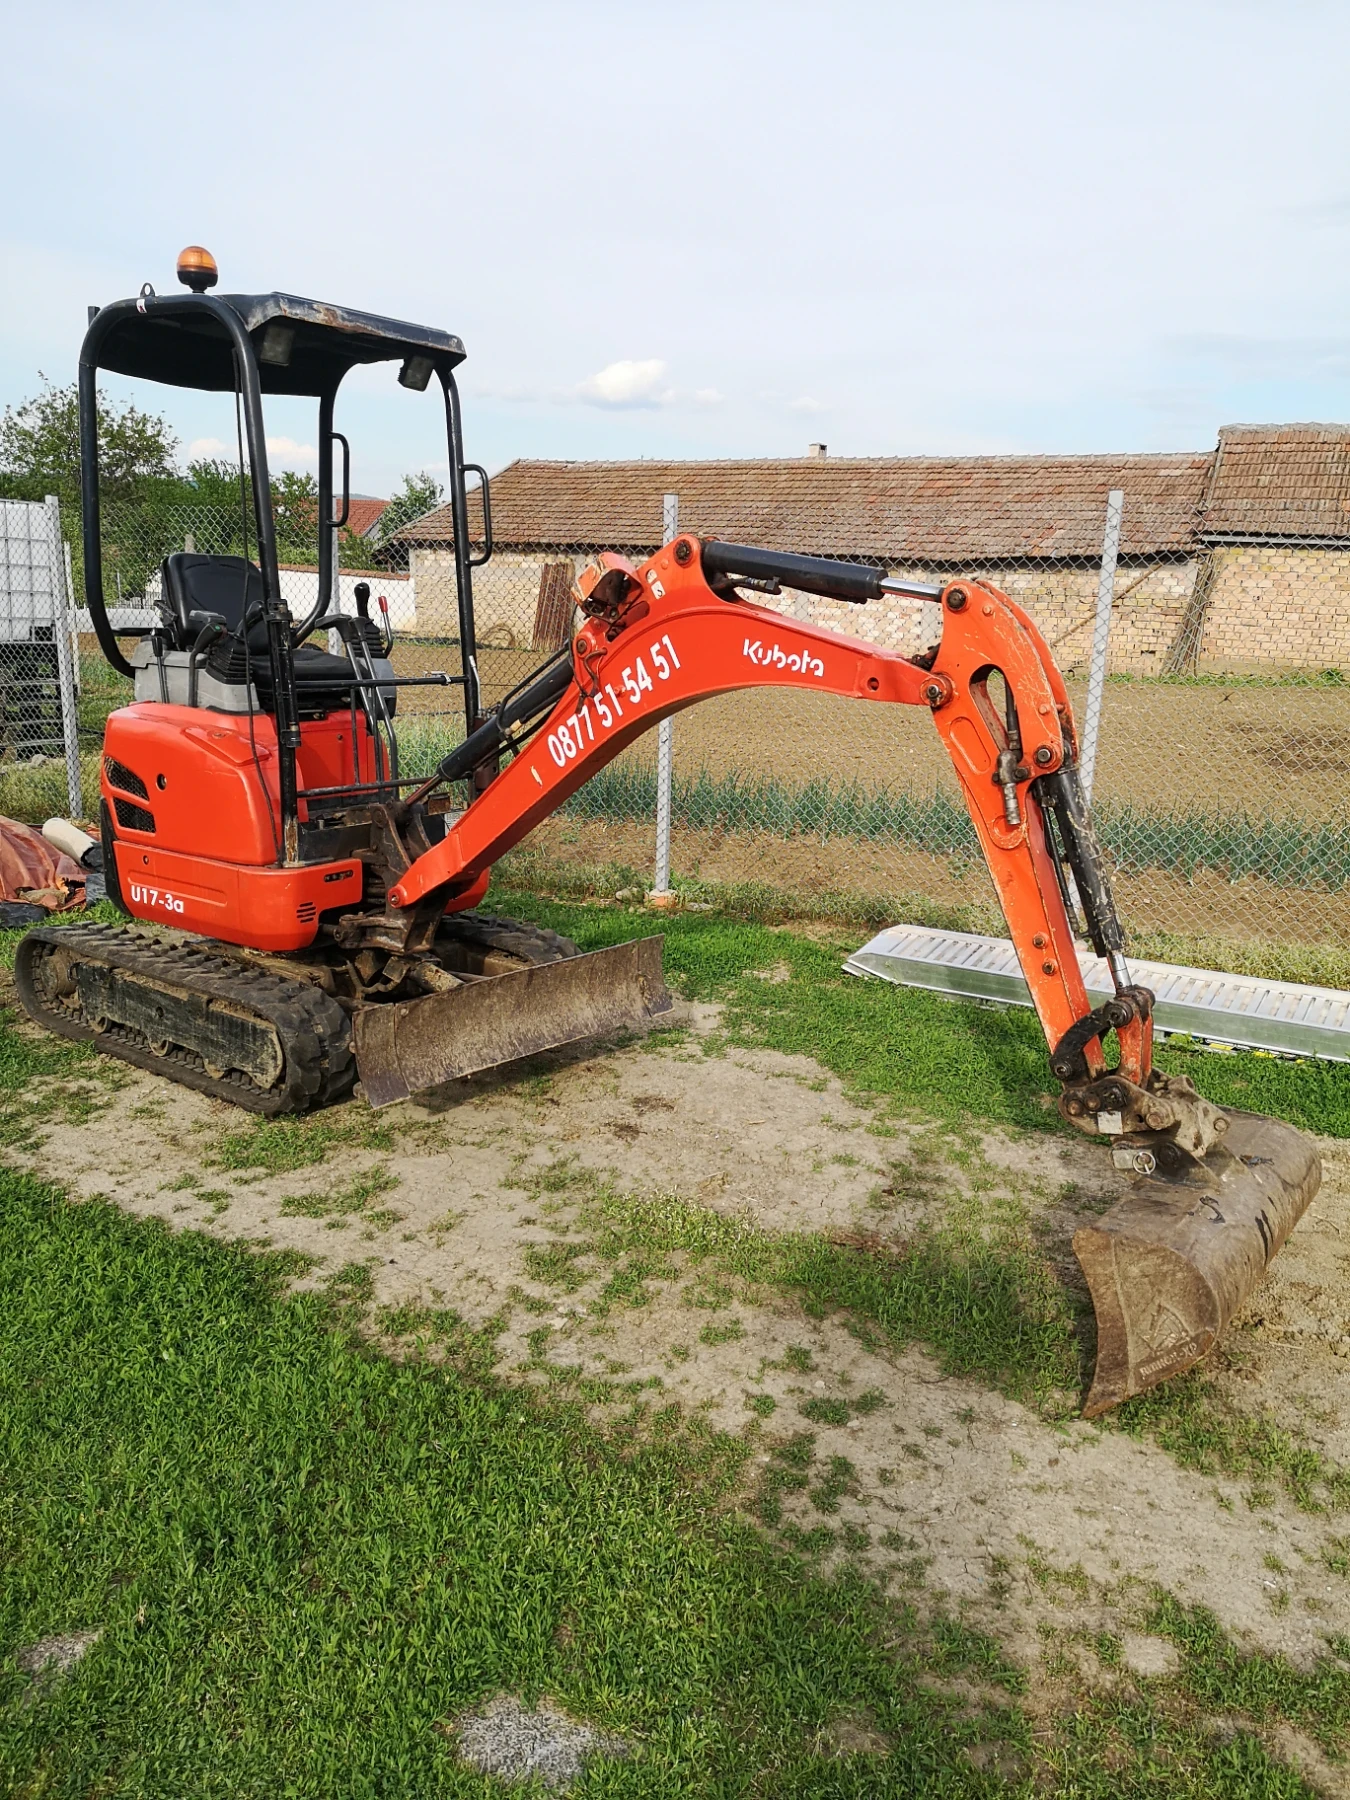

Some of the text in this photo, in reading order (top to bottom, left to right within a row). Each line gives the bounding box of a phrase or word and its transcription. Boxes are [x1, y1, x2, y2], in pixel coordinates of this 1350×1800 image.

[743, 638, 824, 677] Kubota
[547, 634, 681, 768] 0877 51 54 51
[131, 885, 184, 914] U17-3a
